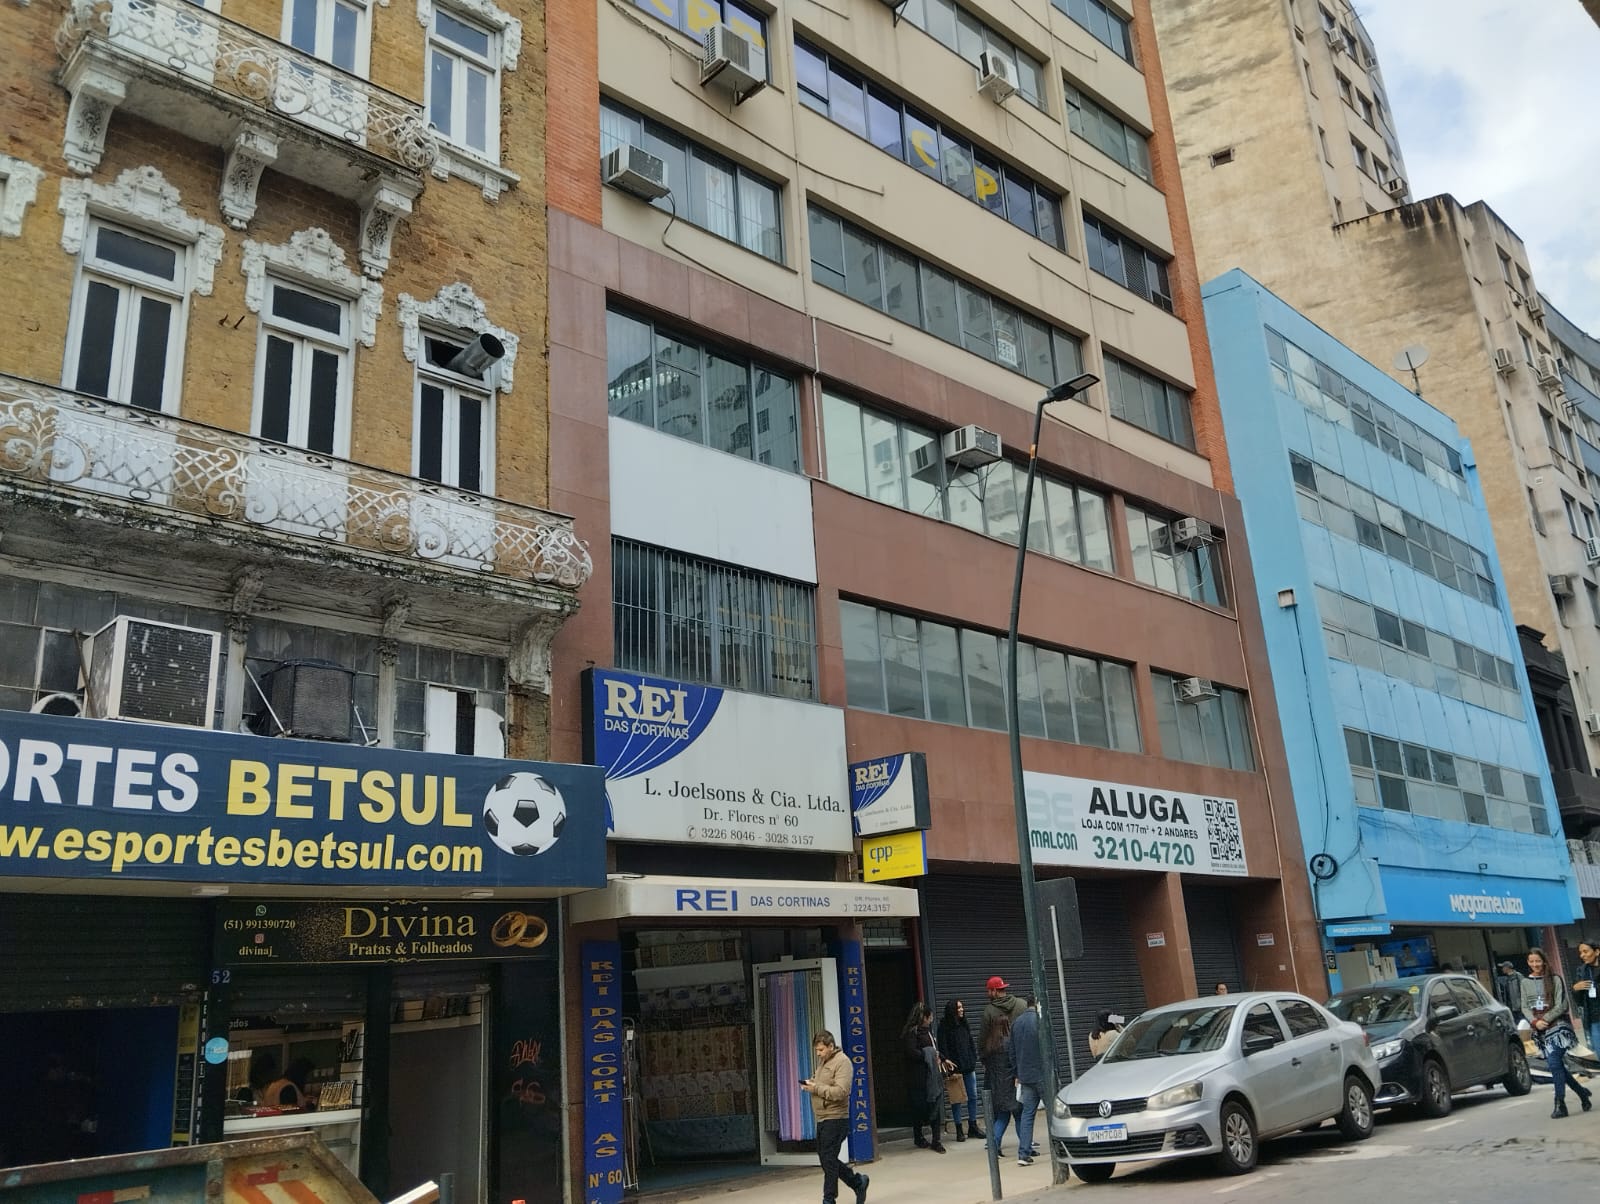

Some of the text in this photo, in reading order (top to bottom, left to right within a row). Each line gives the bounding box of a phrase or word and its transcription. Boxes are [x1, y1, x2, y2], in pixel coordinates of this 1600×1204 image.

[603, 678, 689, 726] REI
[604, 718, 689, 740] DAS CORTINAS
[0, 738, 473, 828] RTES BETSUL
[855, 762, 889, 785] REI
[643, 778, 661, 797] L.
[668, 781, 746, 803] Joelsons
[752, 788, 765, 805] &
[770, 790, 801, 808] Cia.
[807, 794, 846, 813] Ltda.
[1088, 787, 1190, 825] ALUGA
[703, 807, 723, 821] Dr.
[728, 809, 765, 825] Flores
[784, 814, 799, 828] 60
[1081, 817, 1104, 830] LOJA
[1105, 820, 1124, 832] COM
[1157, 826, 1163, 836] 2
[1164, 827, 1199, 840] ANDARES
[701, 828, 728, 840] 3226
[730, 830, 756, 842] 8046
[765, 832, 789, 844] 3028
[791, 834, 814, 846] 3157
[1030, 829, 1078, 851] MALCON
[869, 845, 893, 863] cpp
[1092, 835, 1195, 866] 3210-4720
[675, 889, 738, 912] REI
[750, 895, 831, 908] DAS CORTINAS
[223, 919, 296, 931] (51) 991390720
[341, 906, 477, 938] Divina
[349, 940, 473, 957] Pratas & Folheados
[211, 969, 231, 984] 52
[590, 960, 615, 996] REI
[847, 966, 859, 997] REI
[590, 1007, 617, 1044] DAS
[849, 1006, 863, 1036] DAS
[607, 1168, 623, 1185] 60
